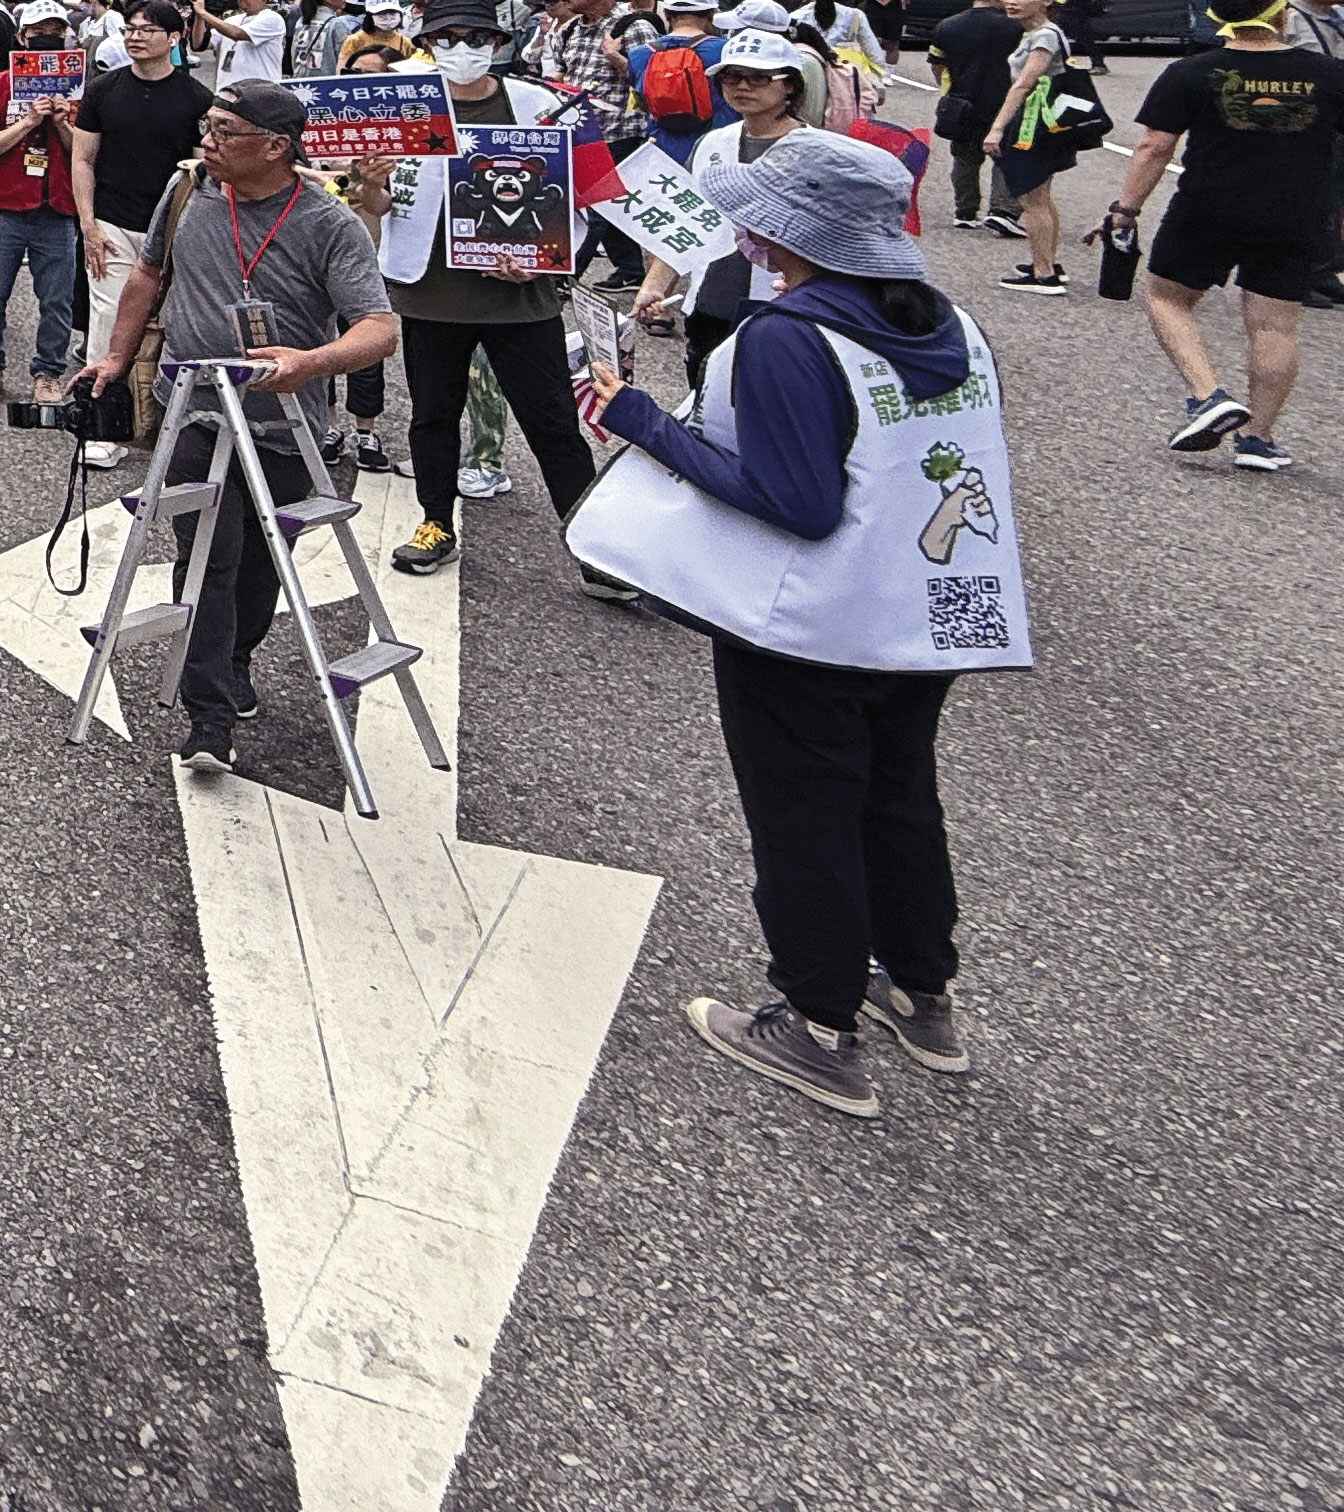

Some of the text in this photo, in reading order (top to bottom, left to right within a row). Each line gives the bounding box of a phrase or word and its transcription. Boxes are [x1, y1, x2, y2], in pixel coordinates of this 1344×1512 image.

[328, 84, 442, 102] 今日不罷免
[1244, 80, 1315, 95] HURLEY
[307, 102, 431, 126] 黑心立委
[301, 126, 403, 144] 明日是香港
[649, 173, 722, 232] 大罷免
[611, 189, 705, 254] 大成宮
